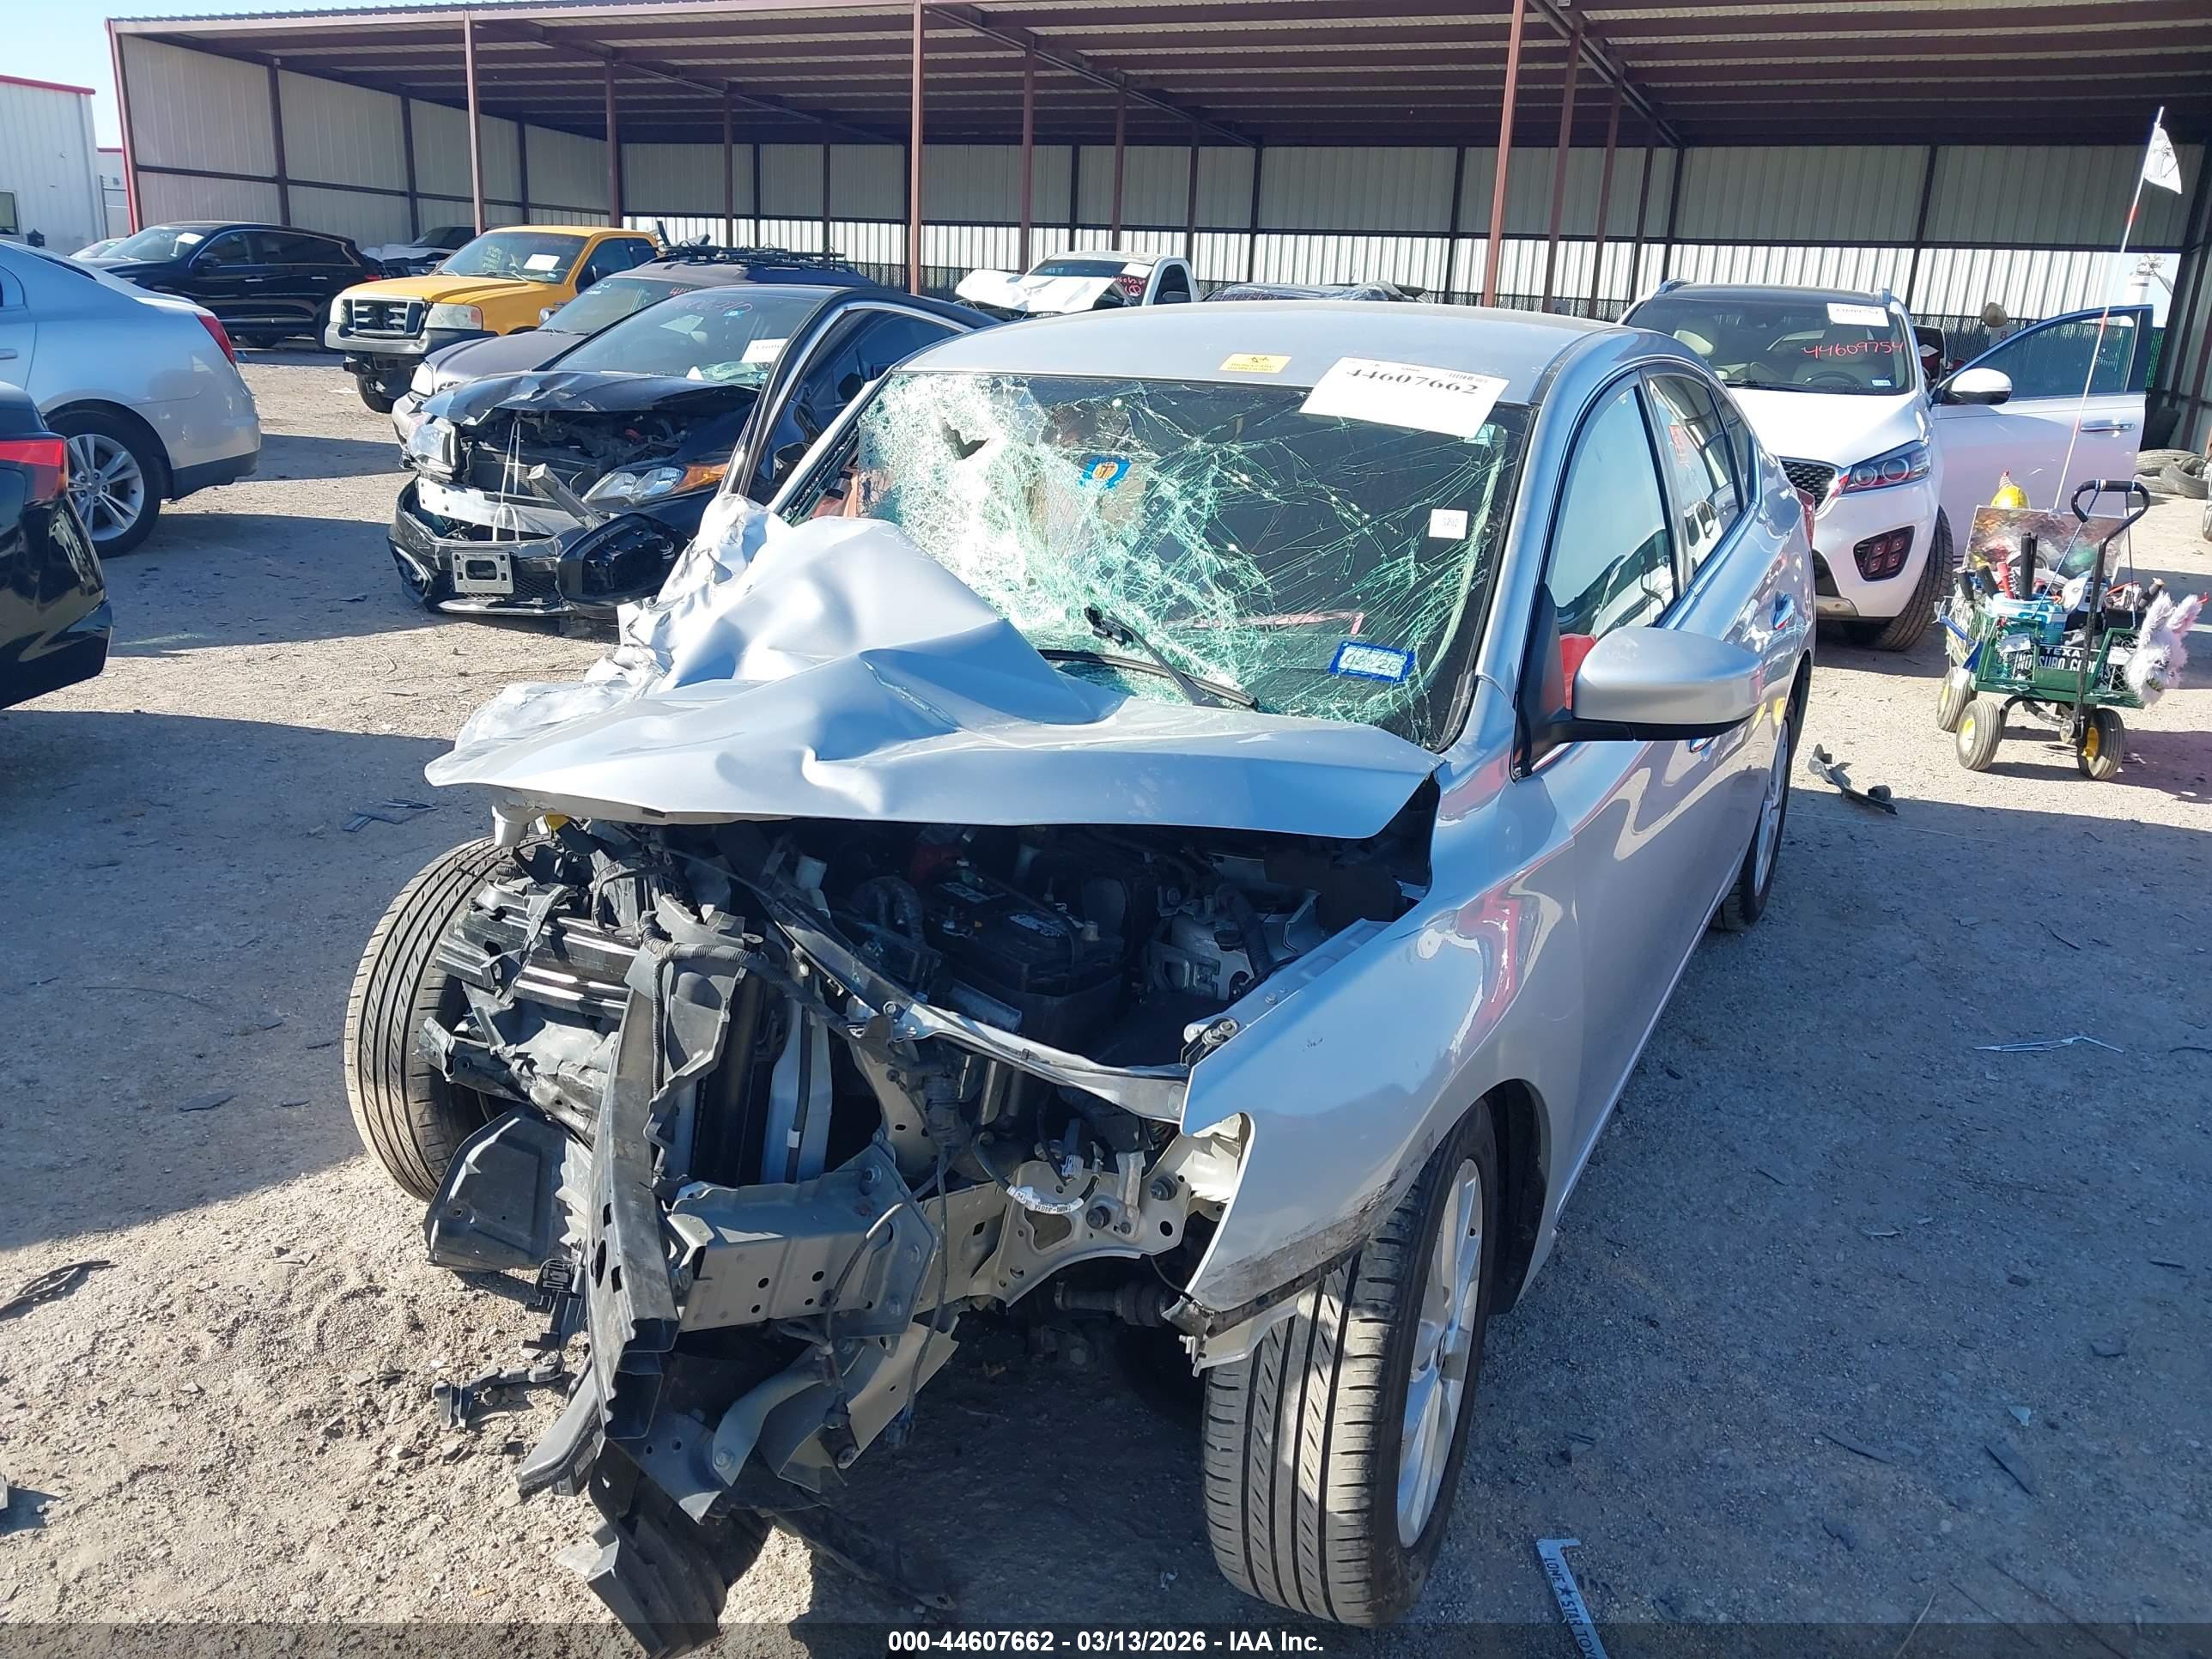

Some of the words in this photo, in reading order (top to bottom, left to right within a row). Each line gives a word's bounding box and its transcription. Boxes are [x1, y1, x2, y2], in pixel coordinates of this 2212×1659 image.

[1801, 341, 1905, 359] 44609754
[1346, 368, 1479, 395] 44607662
[2045, 646, 2081, 658] TEXA
[1544, 1557, 1566, 1583] LONE
[1560, 1600, 1583, 1626] STAR
